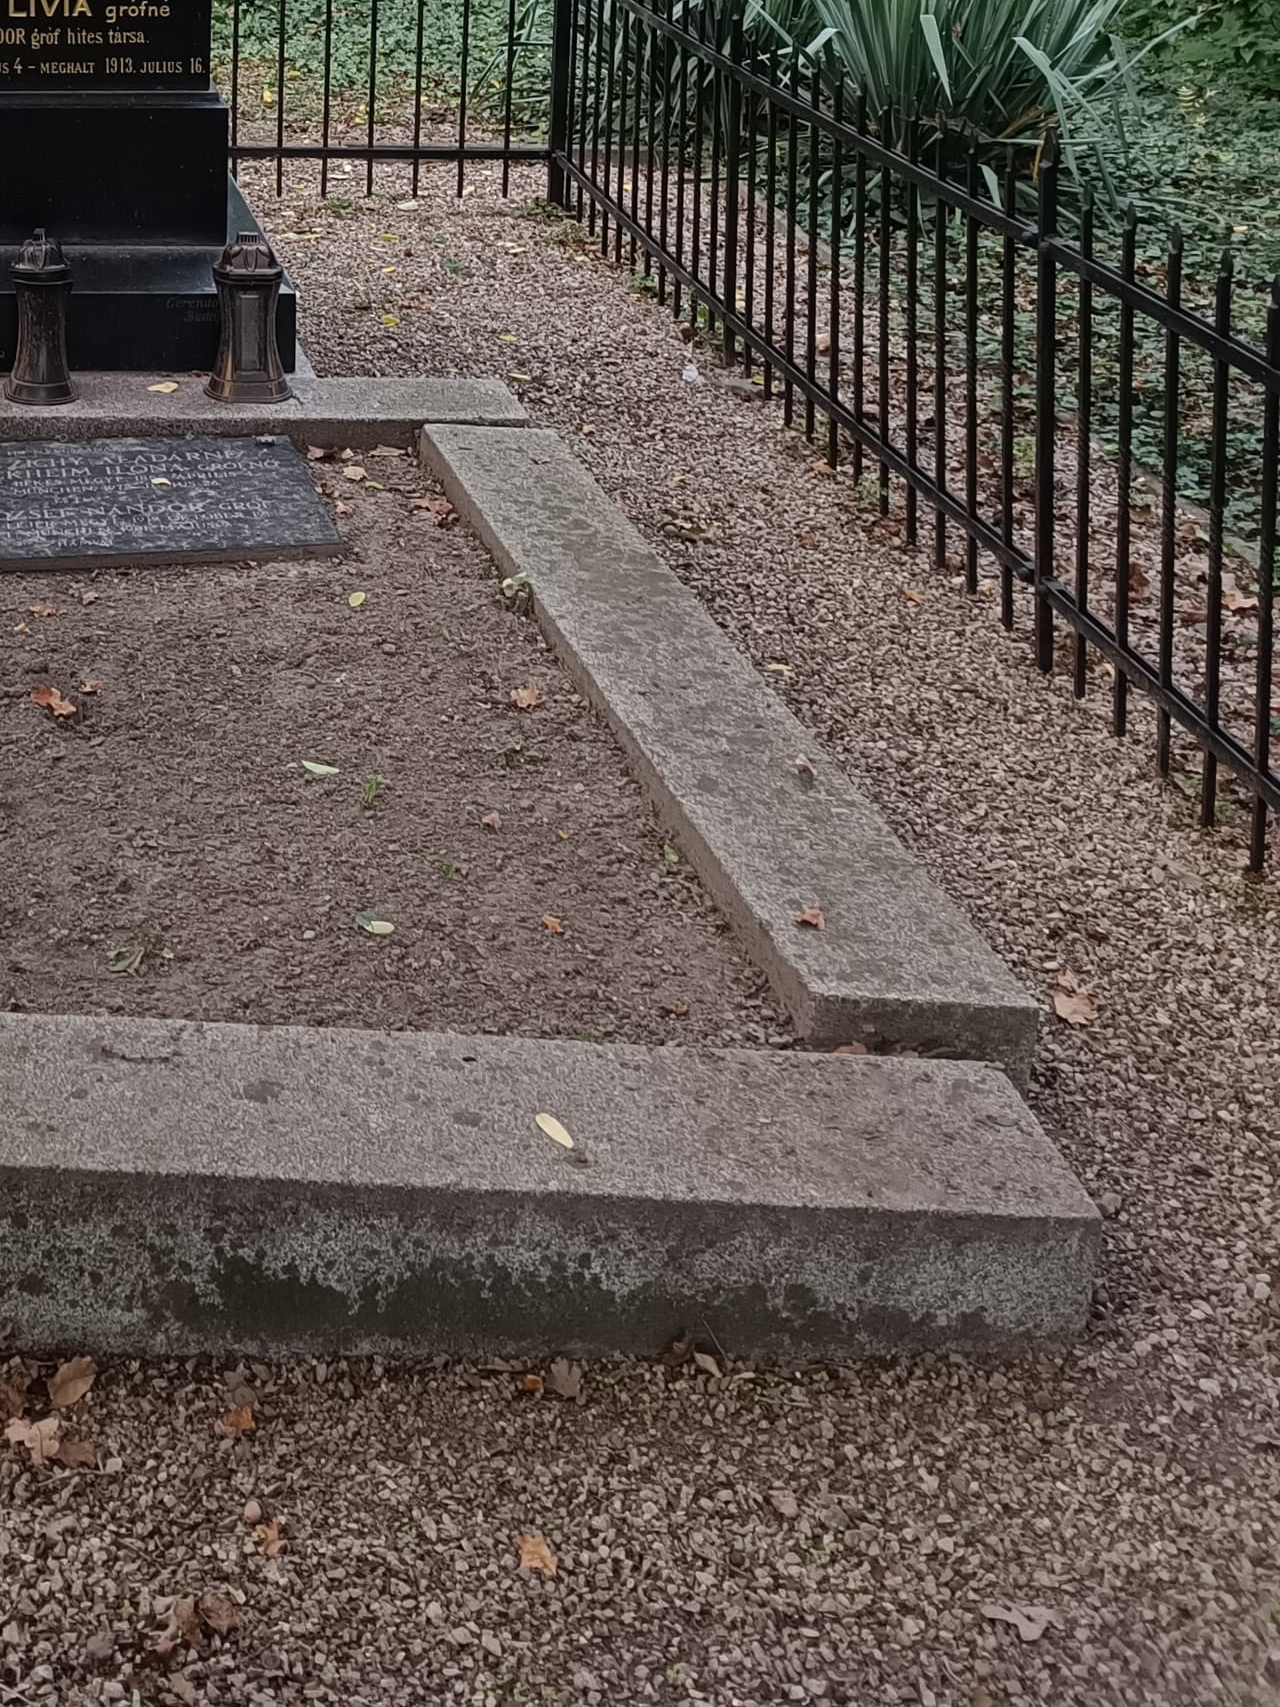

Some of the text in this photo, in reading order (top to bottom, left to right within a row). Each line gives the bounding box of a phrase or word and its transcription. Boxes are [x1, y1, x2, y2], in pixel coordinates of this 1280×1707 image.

[67, 27, 104, 45] hites
[13, 57, 23, 74] 4
[40, 61, 96, 74] MEGHALT
[139, 61, 183, 74] JULIUS
[7, 457, 84, 468] ZICHY
